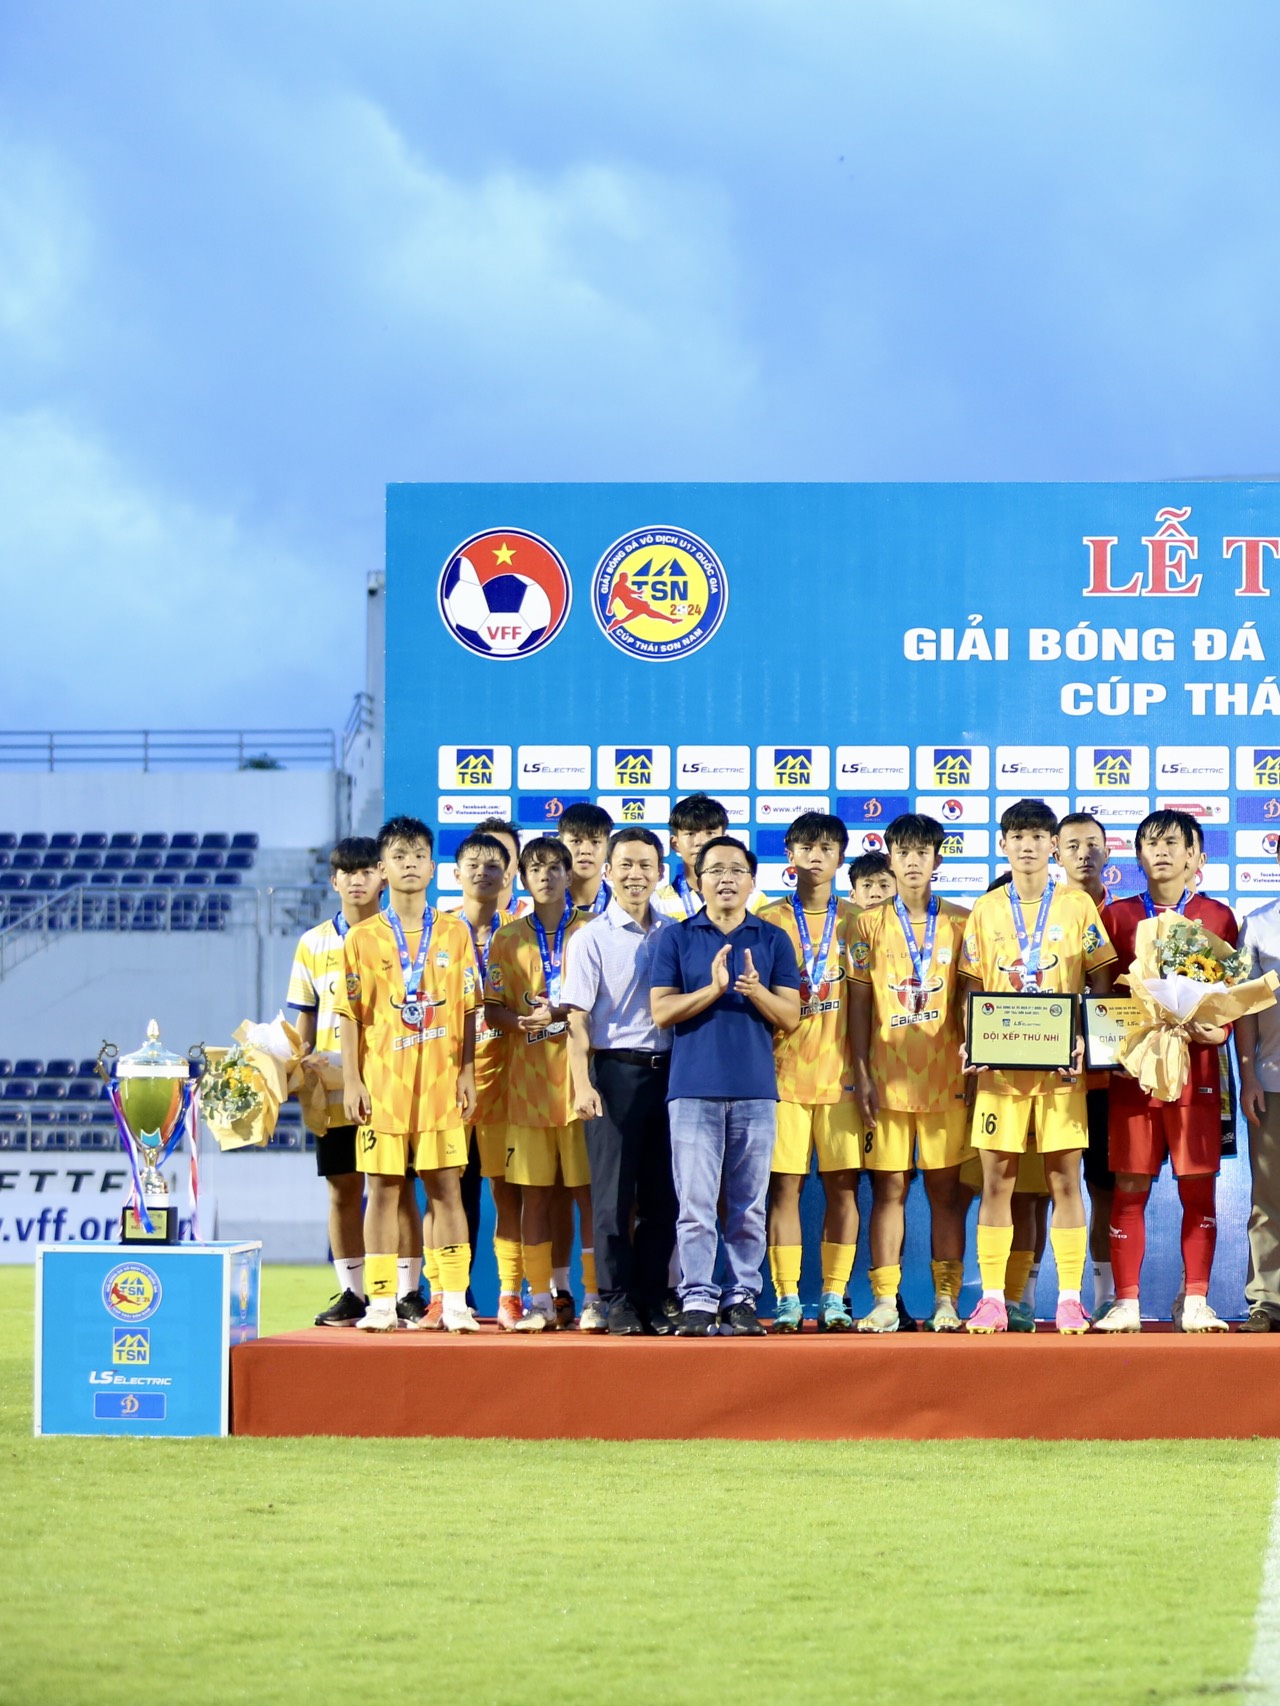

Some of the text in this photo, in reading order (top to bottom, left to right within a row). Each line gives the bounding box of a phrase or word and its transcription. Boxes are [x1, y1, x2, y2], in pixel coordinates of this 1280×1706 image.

[1083, 507, 1203, 597] LỄ
[639, 534, 654, 545] VÔ
[679, 539, 697, 553] U17
[709, 577, 719, 594] GIA
[631, 580, 689, 601] TSN
[487, 626, 522, 640] VFF
[903, 613, 1009, 661] GIẢI
[1029, 620, 1175, 662] BÓNG
[1193, 621, 1266, 661] ĐÁ
[616, 628, 704, 653] CÚP THÁI SƠN NAM
[1060, 675, 1167, 716] CÚP
[523, 763, 540, 773] LS
[682, 763, 700, 773] LS
[842, 763, 860, 773] LS
[1001, 763, 1018, 773] LS
[1161, 763, 1178, 773] LS
[459, 772, 492, 784] TSN
[618, 772, 651, 784] TSN
[777, 772, 810, 784] TSN
[936, 772, 969, 784] TSN
[1096, 772, 1129, 785] TSN
[622, 810, 644, 820] TSN
[1081, 806, 1099, 814] LS
[942, 845, 963, 854] TSN
[890, 1010, 939, 1027] Carabao
[394, 1026, 447, 1051] Carabao
[1002, 1031, 1020, 1040] XẾP
[981, 1112, 998, 1136] 16
[362, 1130, 377, 1153] 13
[864, 1131, 874, 1154] 8
[506, 1148, 515, 1167] 7
[120, 1286, 145, 1296] TSN
[116, 1350, 146, 1360] TSN
[89, 1371, 114, 1384] LS
